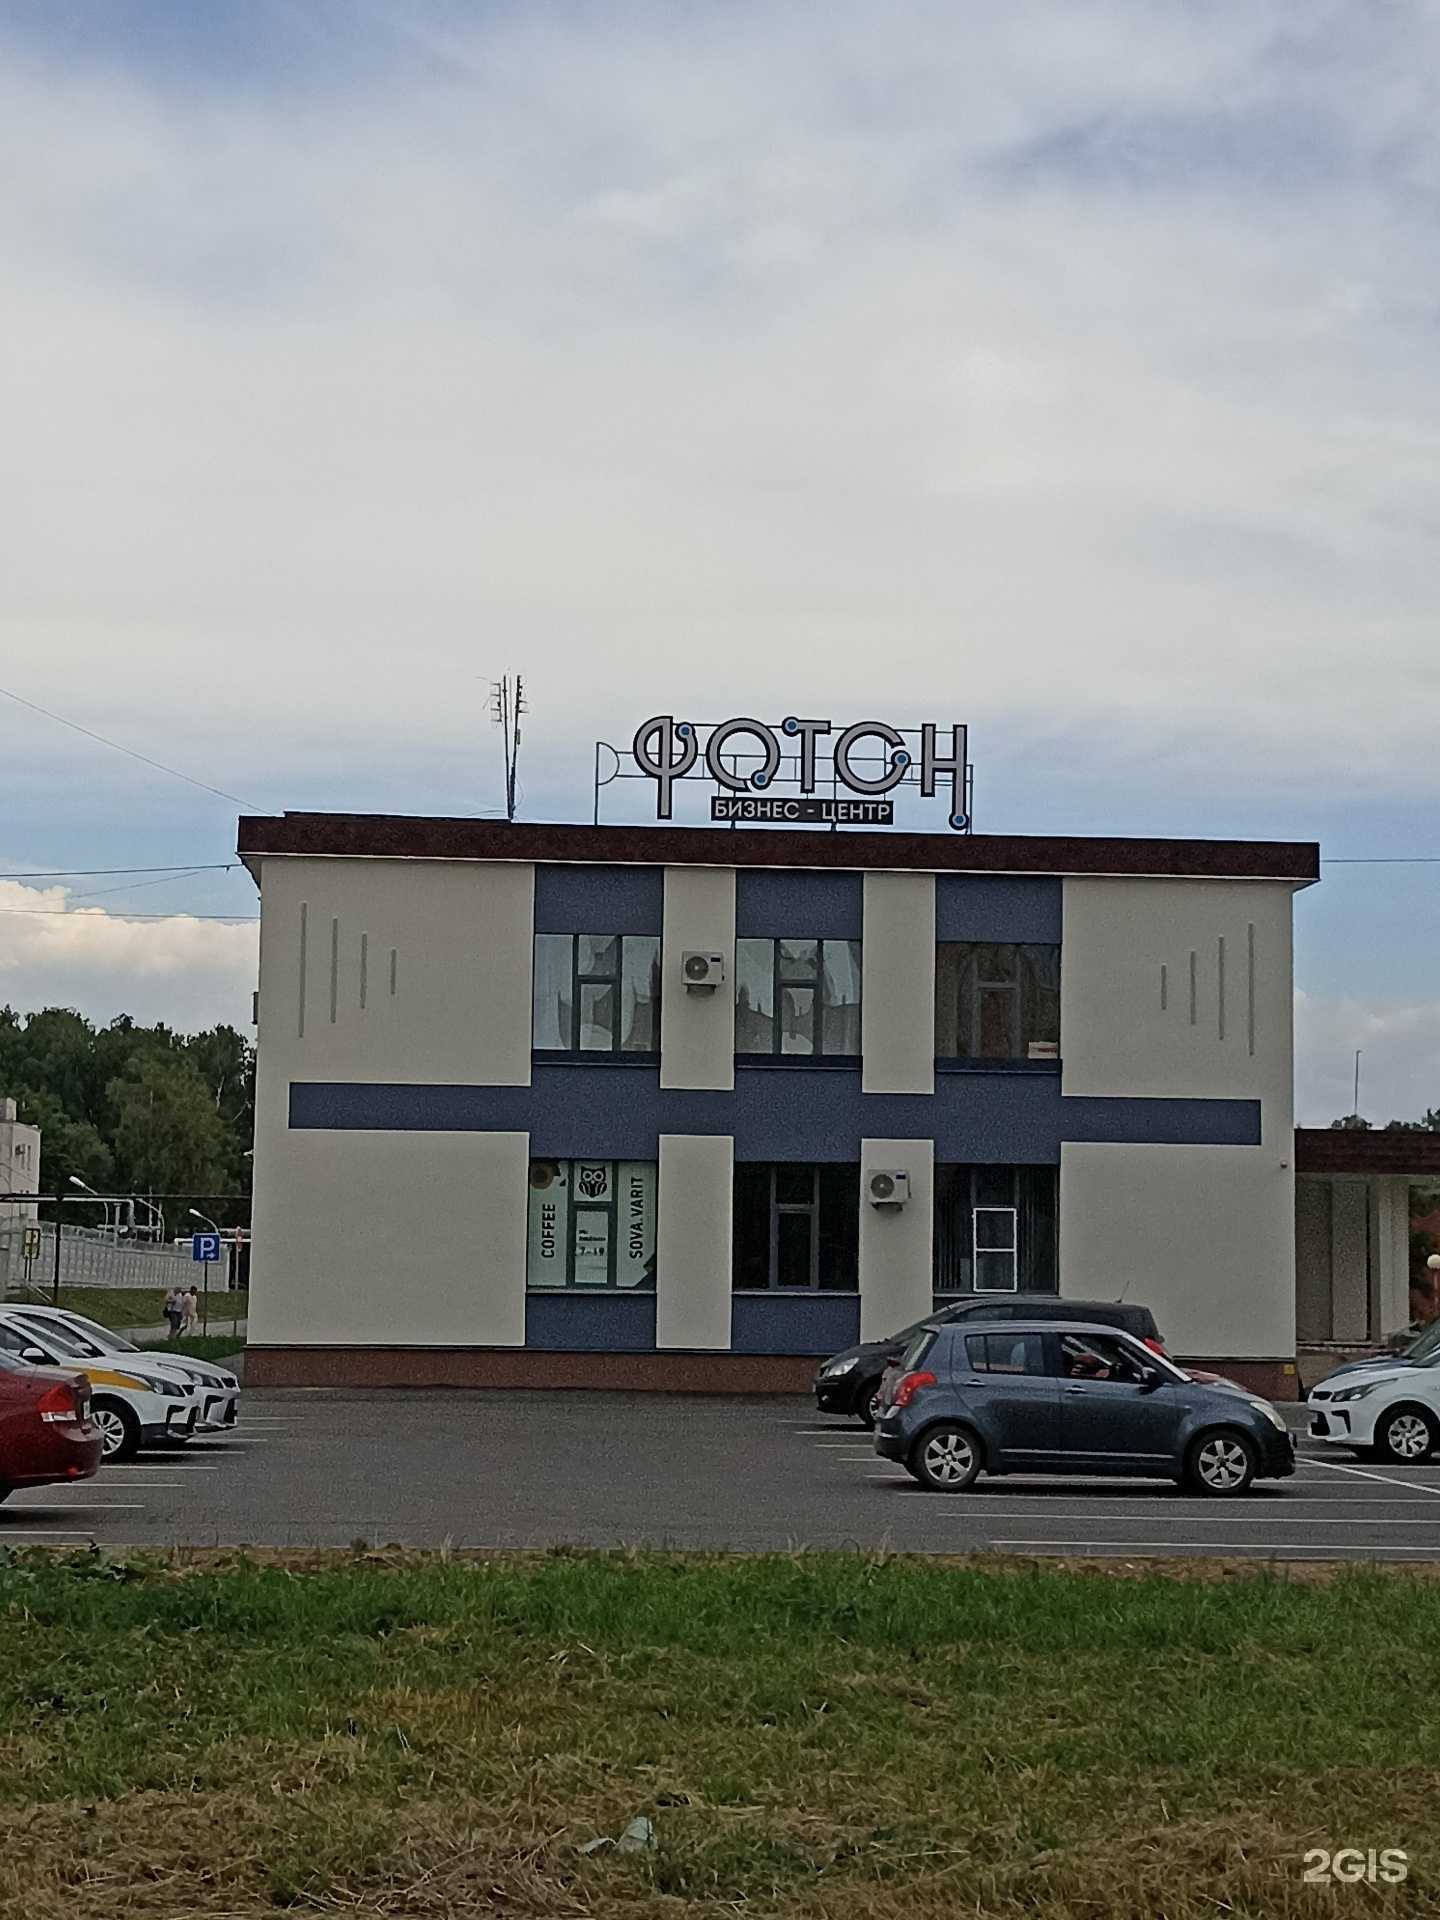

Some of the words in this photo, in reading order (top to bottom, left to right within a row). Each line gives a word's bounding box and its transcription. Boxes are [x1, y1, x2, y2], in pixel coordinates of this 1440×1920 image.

[633, 715, 969, 831] ФОТОН
[714, 800, 800, 819] БИЗНЕС
[821, 802, 891, 823] ЦЕНТР
[541, 1203, 556, 1259] COFFEE
[629, 1176, 644, 1259] SOVA.VARIT
[200, 1237, 215, 1259] P
